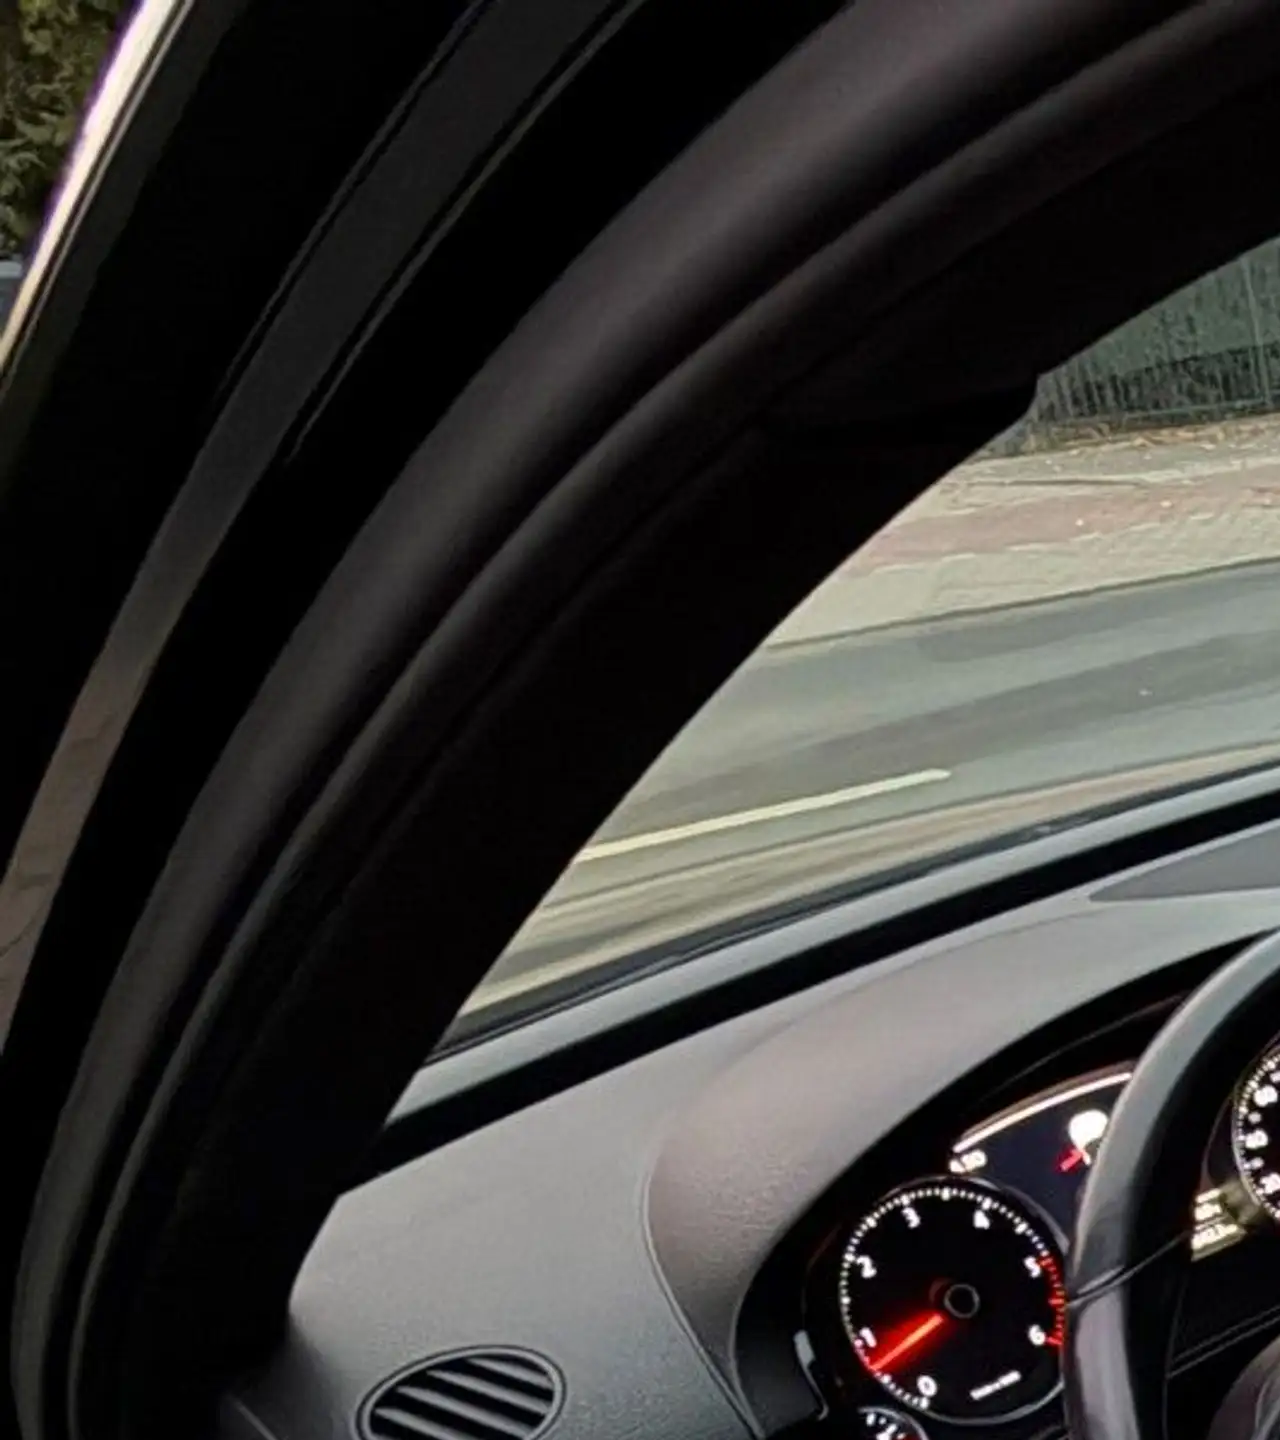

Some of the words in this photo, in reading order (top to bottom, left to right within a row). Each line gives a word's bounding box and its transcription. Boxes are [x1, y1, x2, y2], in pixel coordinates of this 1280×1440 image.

[902, 1206, 921, 1229] 3
[973, 1209, 991, 1230] 4
[856, 1255, 877, 1278] 2
[1024, 1255, 1042, 1279] 5
[859, 1326, 877, 1349] 1
[1028, 1323, 1046, 1346] 6
[916, 1373, 938, 1398] 0
